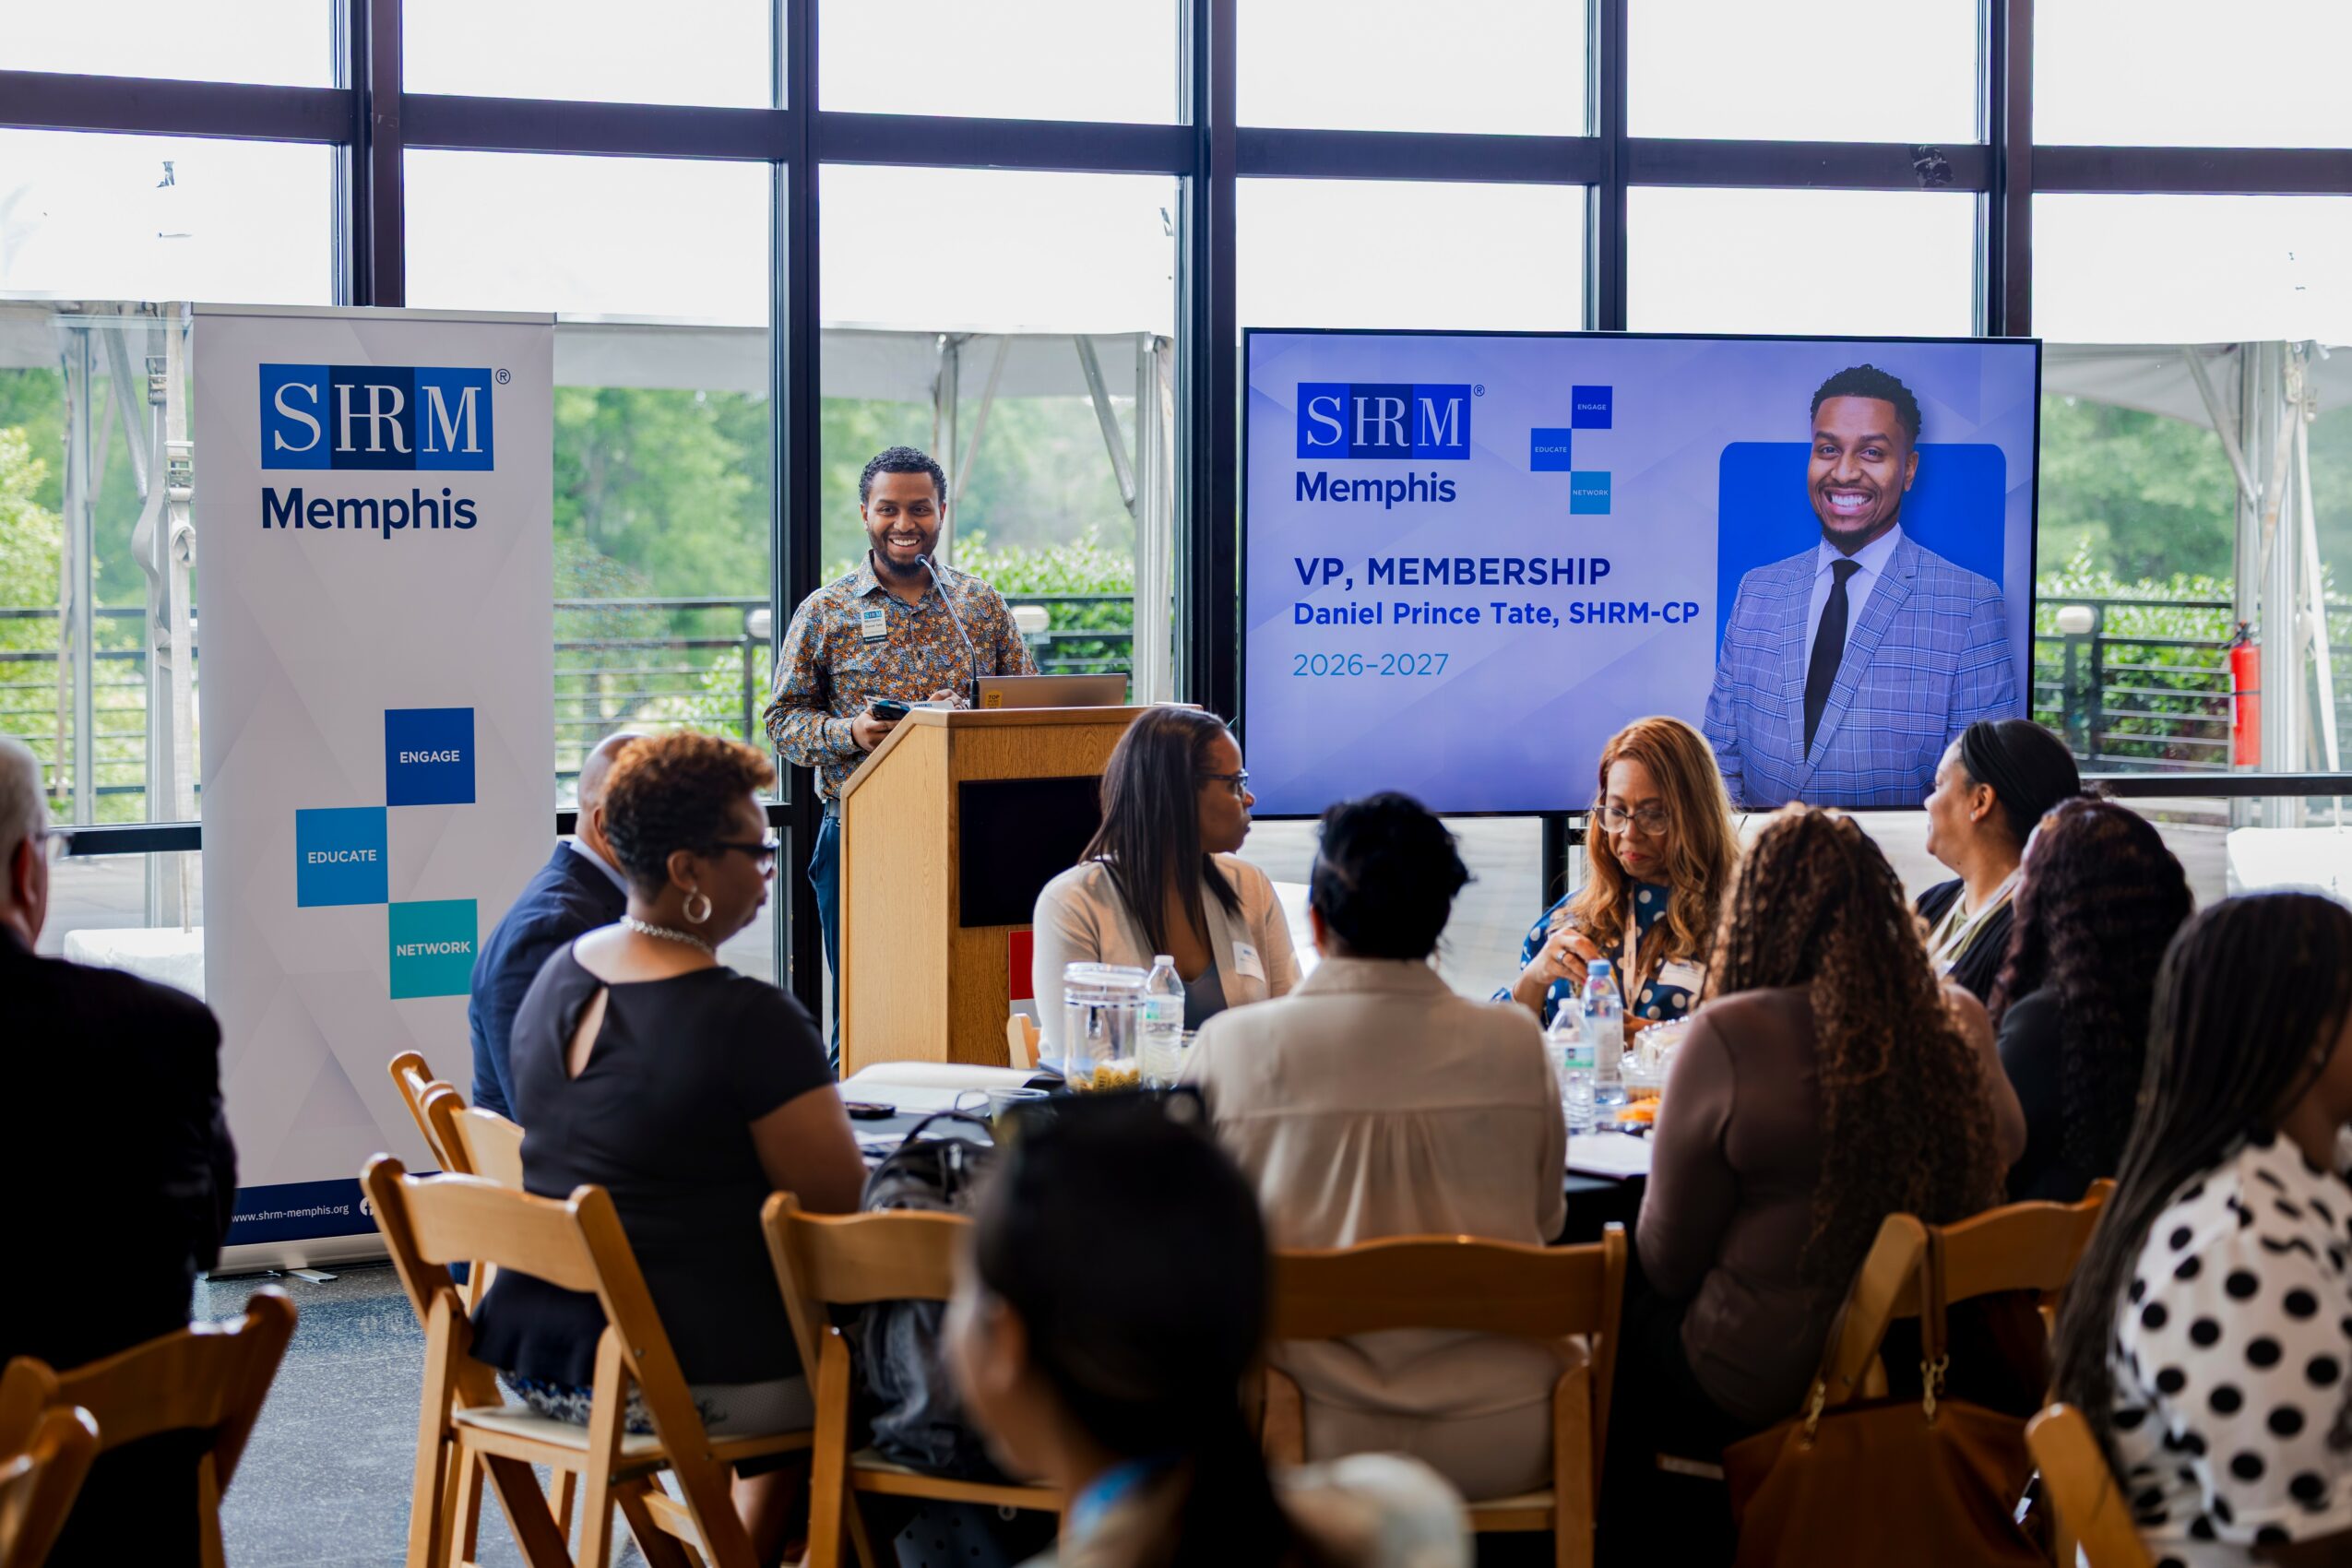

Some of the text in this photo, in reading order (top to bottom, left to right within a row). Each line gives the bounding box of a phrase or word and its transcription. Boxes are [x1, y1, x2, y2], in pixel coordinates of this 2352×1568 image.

[274, 382, 483, 454] SHRM
[1307, 396, 1463, 448] SHRM
[1296, 471, 1457, 510] Memphis
[261, 487, 478, 540] Memphis
[1294, 557, 1611, 591] VP, MEMBERSHIP
[1294, 601, 1700, 629] Daniel Prince Tate, SHRM-CP
[399, 750, 460, 764] ENGAGE
[307, 849, 377, 864] EDUCATE
[396, 941, 471, 956] NETWORK
[232, 1204, 350, 1223] www.shrm-memphis.org
